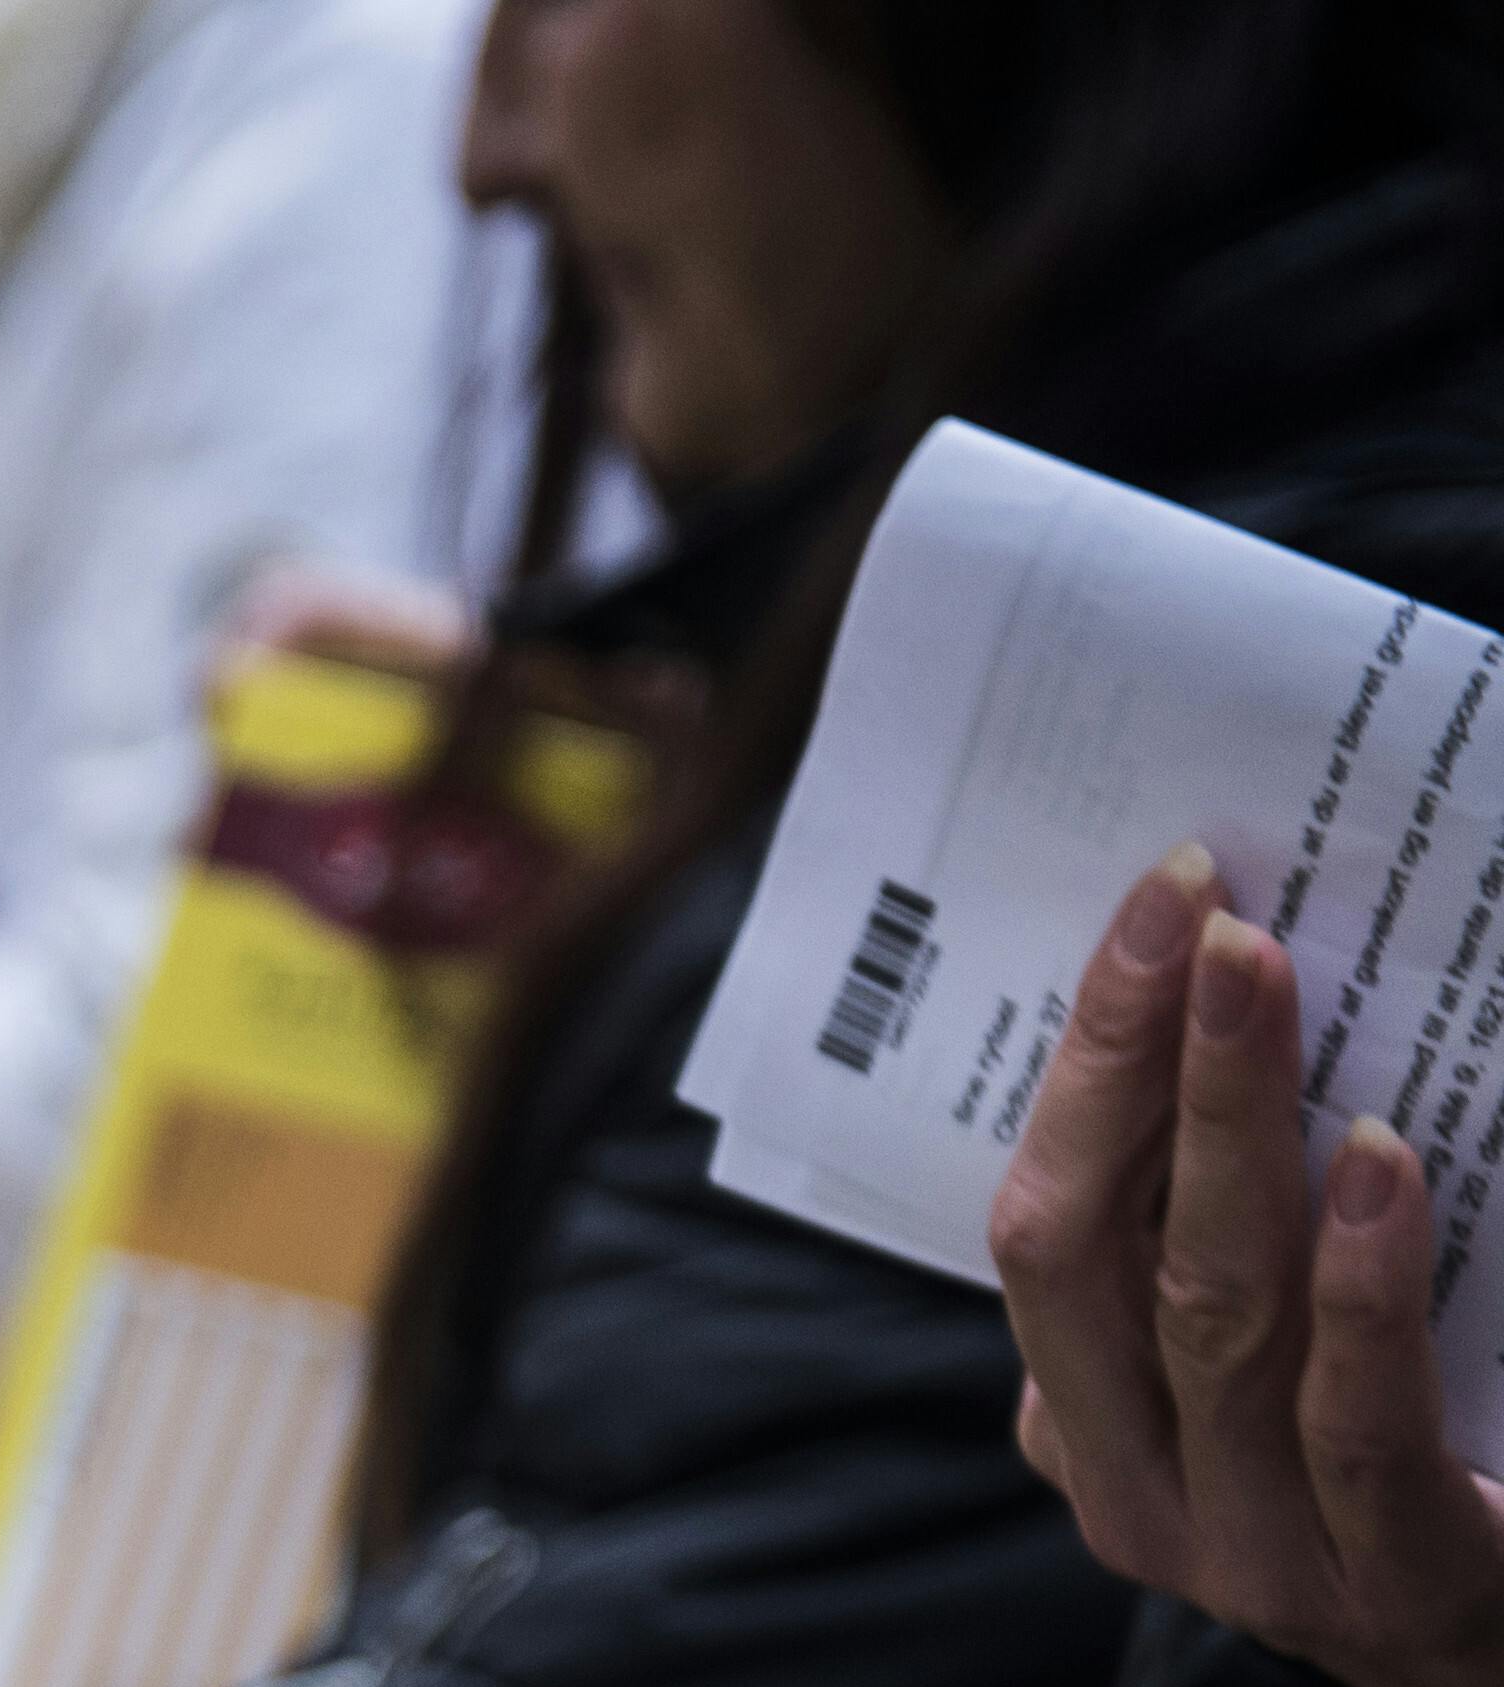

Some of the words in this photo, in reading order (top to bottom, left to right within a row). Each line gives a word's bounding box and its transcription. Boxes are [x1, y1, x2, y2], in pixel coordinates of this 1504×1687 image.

[1313, 787, 1339, 824] du
[1335, 664, 1386, 751] blevet
[1423, 669, 1490, 792] julepose
[1399, 829, 1430, 867] og
[1413, 790, 1439, 827] en
[1355, 867, 1411, 987] gavekort
[1445, 904, 1492, 981] hente
